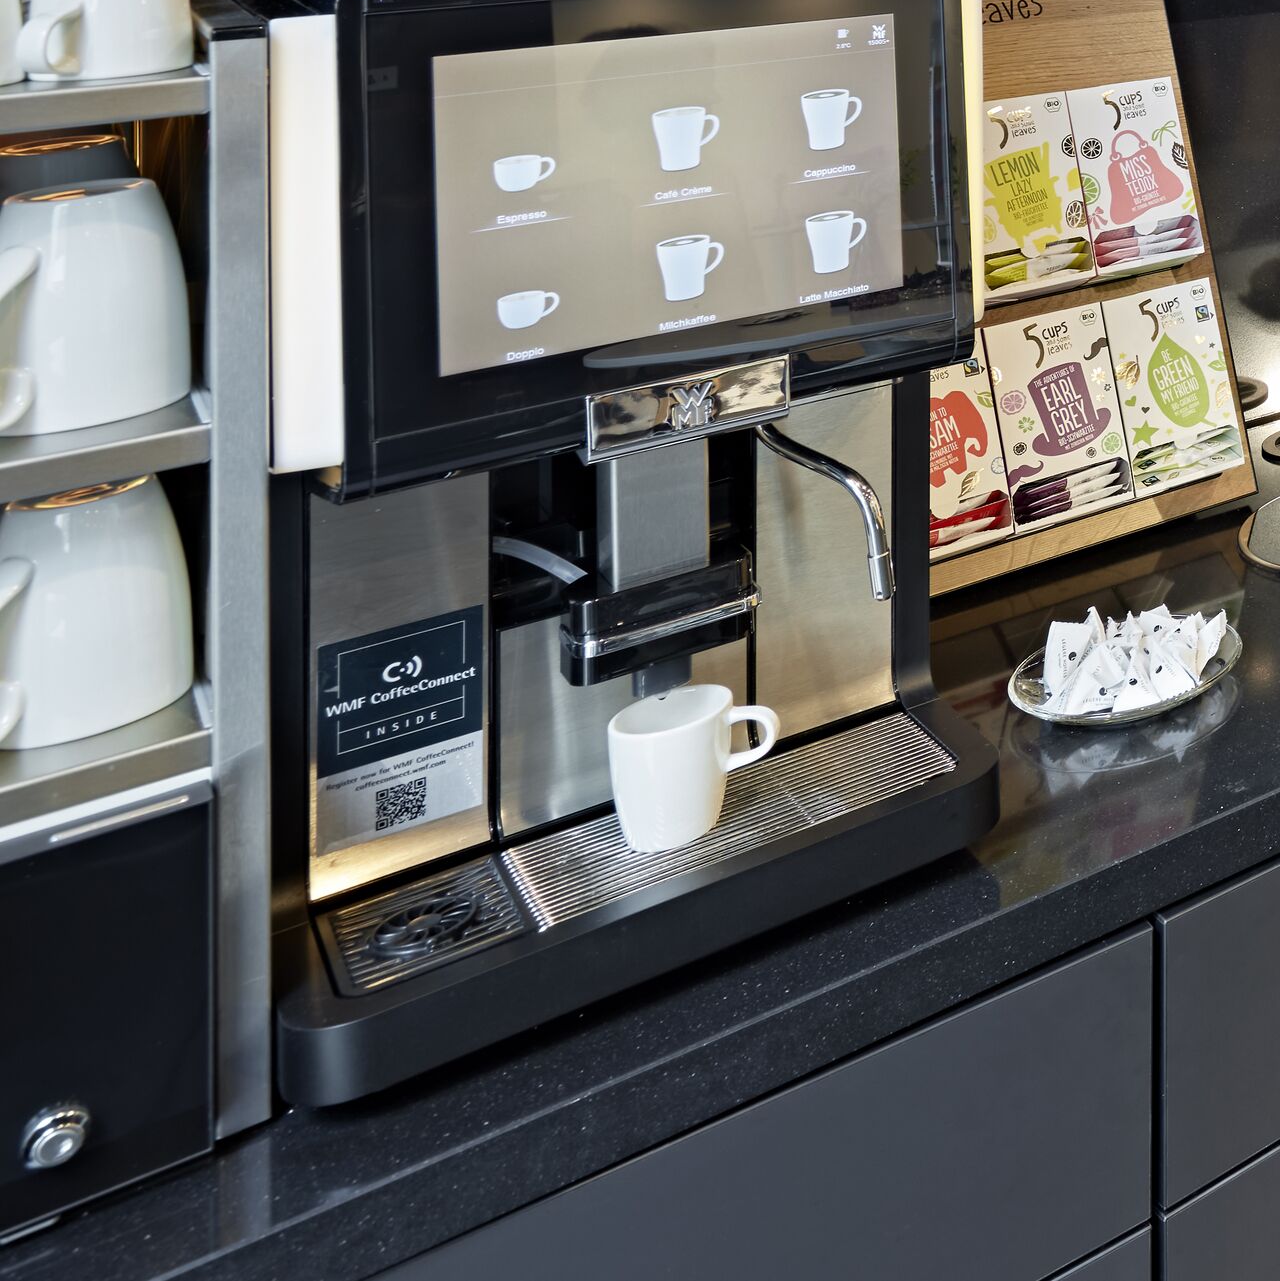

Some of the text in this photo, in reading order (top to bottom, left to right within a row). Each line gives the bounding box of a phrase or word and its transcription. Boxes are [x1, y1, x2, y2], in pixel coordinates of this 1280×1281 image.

[1119, 91, 1142, 106] CUPS
[1124, 108, 1147, 120] leaves
[1011, 125, 1036, 138] leaves
[804, 163, 856, 178] Cappuccino
[990, 151, 1040, 187] LEMON
[1119, 155, 1152, 182] MISS
[655, 185, 712, 201] Café Crème
[1010, 178, 1033, 197] LAZY
[1125, 174, 1159, 197] TEDOX
[1006, 188, 1048, 213] AFTERNOON
[497, 210, 547, 225] Espresso
[800, 284, 869, 304] Latte Macchiato
[659, 313, 716, 331] Milchkaffee
[1082, 312, 1095, 321] BIO
[1139, 297, 1180, 342] 5 CUPS
[507, 347, 544, 363] Doppio
[1023, 321, 1068, 369] 5 CUPS
[1048, 342, 1072, 356] leaves
[1161, 349, 1173, 363] BE
[1152, 354, 1194, 391] GREEN
[1040, 376, 1081, 412] EARL
[1160, 376, 1200, 405] MY FRIEND
[671, 381, 714, 430] WMF
[938, 407, 947, 418] TO
[1051, 399, 1088, 436] GREY
[325, 666, 477, 718] WMF CoffeeConnect
[366, 711, 438, 740] INSIDE
[326, 741, 475, 791] Register now for WMF CoffeeConnect!
[355, 759, 447, 792] coffeeconnect.wmf.com
